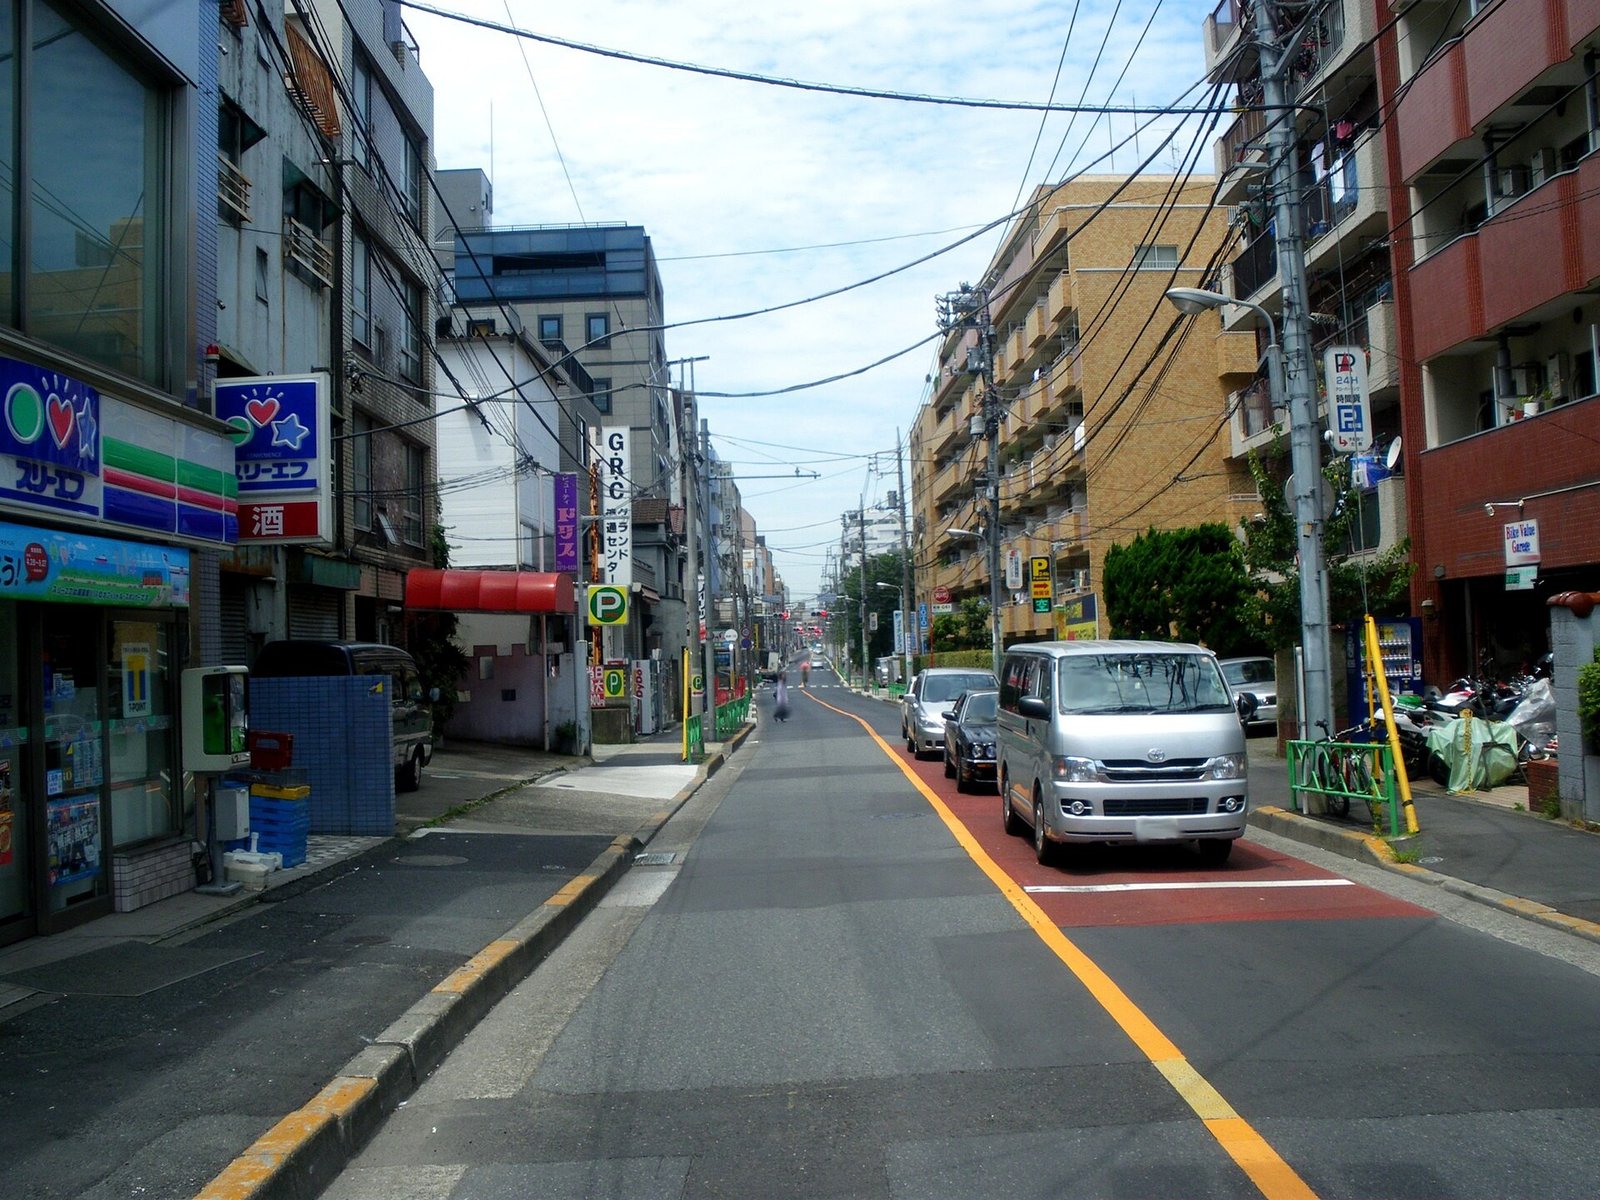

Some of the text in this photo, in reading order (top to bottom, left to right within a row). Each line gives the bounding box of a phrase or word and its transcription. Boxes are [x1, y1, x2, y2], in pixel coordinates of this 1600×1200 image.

[1336, 376, 1359, 385] 24H
[16, 460, 85, 500] スリーエフ
[252, 506, 284, 535] 酒
[557, 507, 576, 557] ドリス
[617, 508, 629, 560] グランド
[1032, 559, 1048, 577] P
[596, 592, 622, 618] P
[610, 673, 618, 693] P
[635, 669, 645, 698] DyDo
[128, 702, 147, 714] T-POINT
